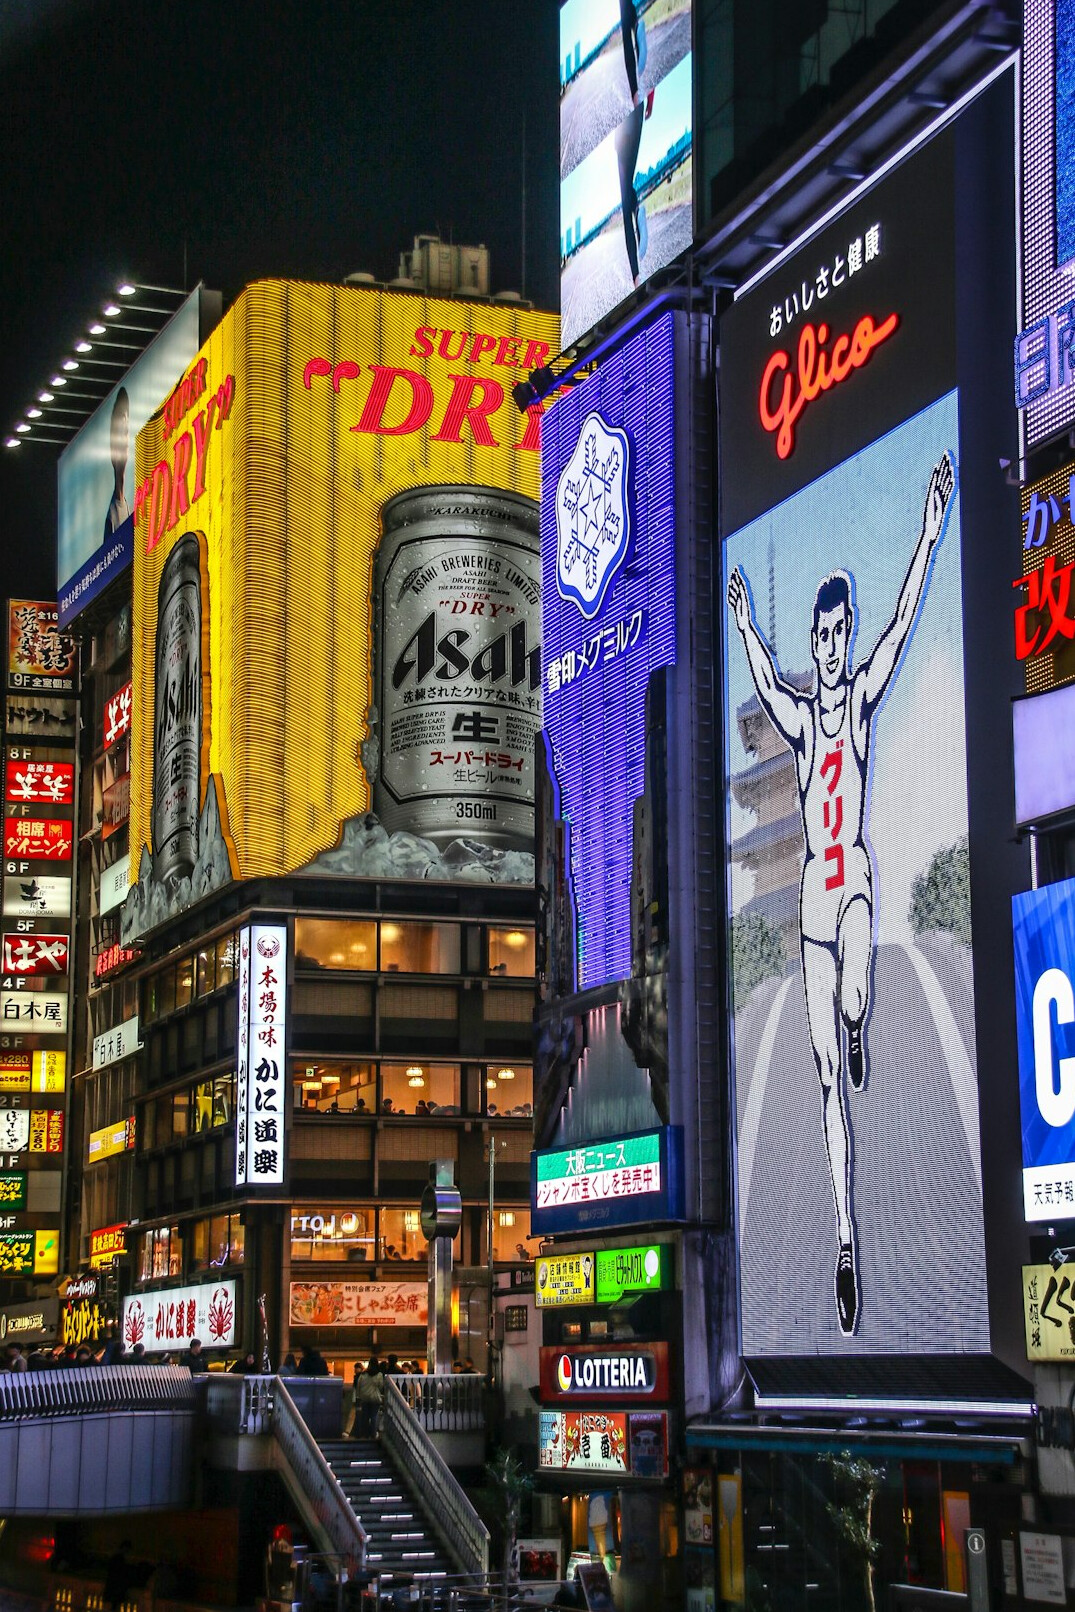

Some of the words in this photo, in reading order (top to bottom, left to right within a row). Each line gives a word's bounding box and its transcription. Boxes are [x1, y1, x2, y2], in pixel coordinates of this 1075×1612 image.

[769, 222, 880, 337] おいしさと健康
[409, 326, 550, 369] SUPER
[759, 313, 898, 459] Glico
[163, 357, 207, 440] SUPER
[411, 566, 438, 595] ASAHI
[441, 555, 501, 575] BREWERIES
[505, 568, 540, 605] LIMITED
[452, 577, 475, 585] DRAFT
[477, 579, 498, 587] BEER
[460, 592, 491, 600] SUPER
[547, 610, 643, 693] 雪印メグミルク
[14, 674, 30, 686] 9F
[406, 713, 424, 721] SUPER
[452, 711, 500, 745] 生
[10, 748, 32, 760] 8F
[430, 751, 524, 772] スーパードライ
[8, 804, 31, 816] 7F
[456, 802, 497, 820] 350ml
[819, 739, 845, 891] グリコ
[16, 821, 46, 837] 相席
[7, 837, 72, 857] ダイニング
[7, 861, 30, 874] 6F
[17, 920, 35, 932] 5F
[5, 939, 67, 971] はや
[3, 977, 26, 989] 4F
[4, 998, 62, 1021] 白木屋
[258, 965, 278, 1048] 本場の味
[1, 1036, 24, 1048] 3F
[101, 1032, 122, 1065] 白木屋
[566, 1143, 626, 1176] 大阪ニュース
[1033, 1180, 1074, 1206] 天気予報
[575, 1358, 646, 1386] LOTTERIA
